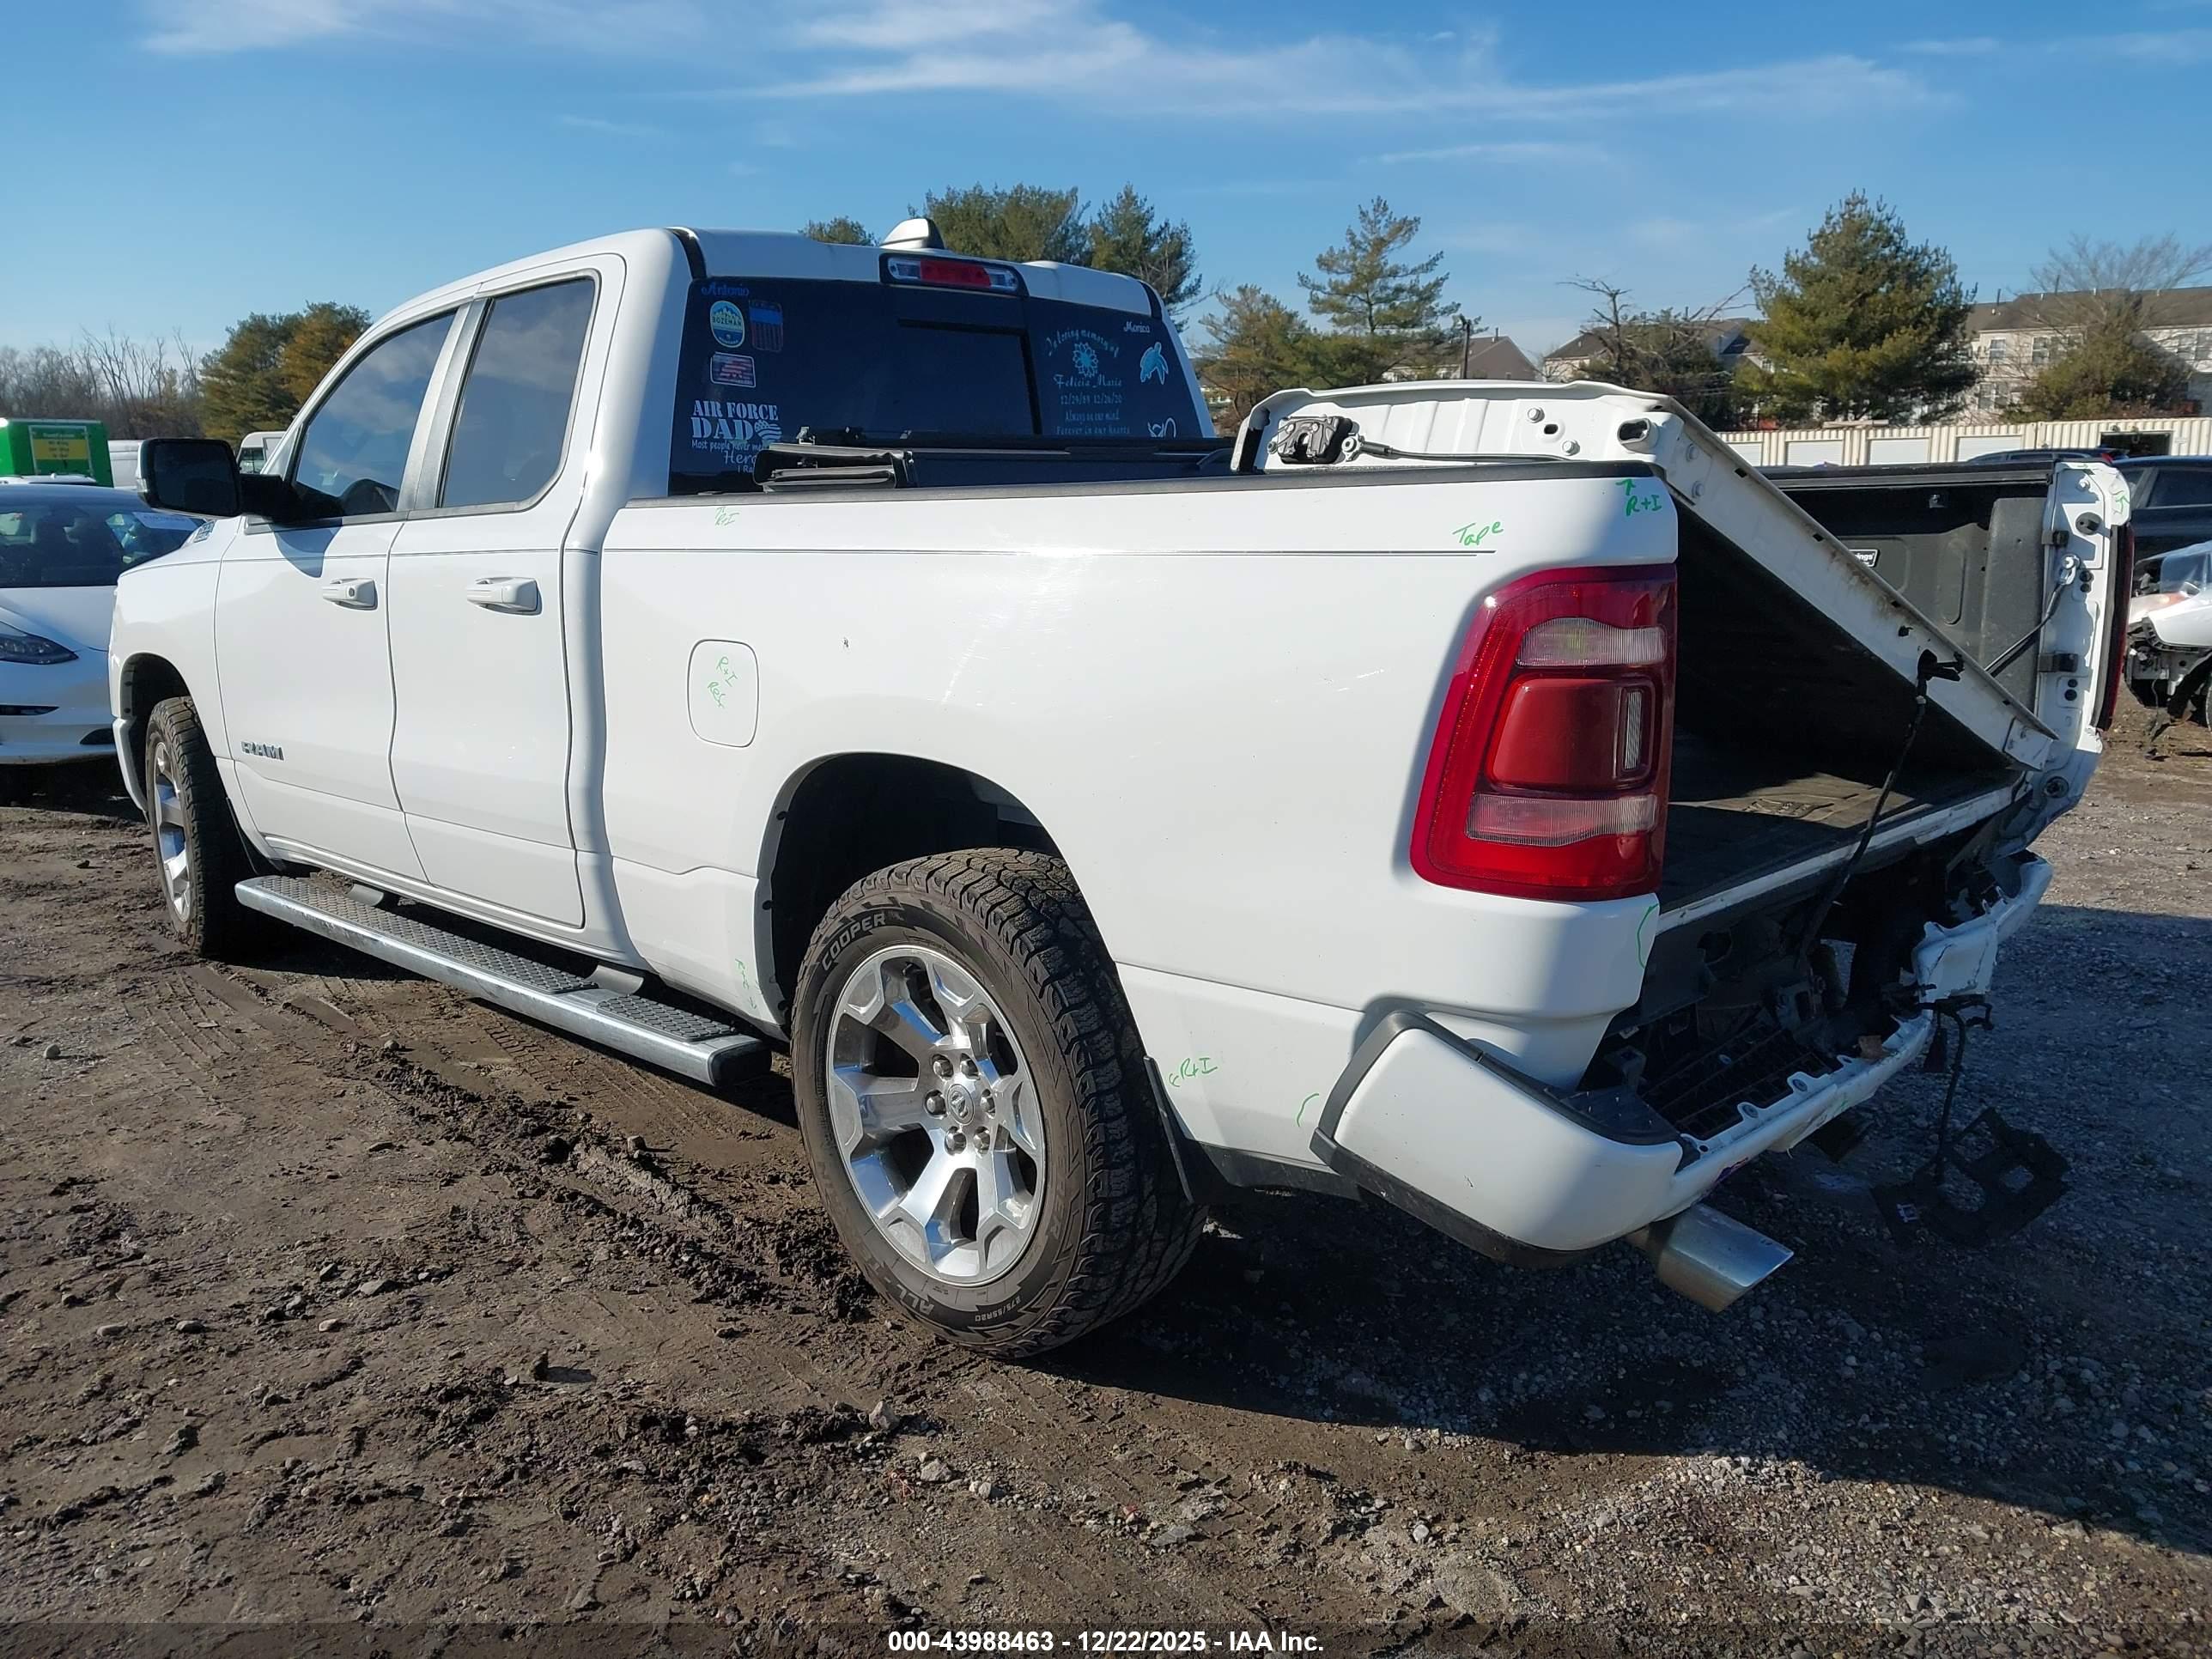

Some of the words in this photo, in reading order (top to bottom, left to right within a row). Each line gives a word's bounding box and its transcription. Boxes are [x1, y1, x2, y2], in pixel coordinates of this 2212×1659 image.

[712, 315, 742, 327] BOZEMAN
[693, 400, 723, 417] AIR
[726, 402, 779, 421] FORCE
[690, 416, 754, 441] DAD
[691, 440, 708, 449] Most
[709, 441, 730, 453] people
[1452, 520, 1504, 546] Tape
[241, 741, 284, 761] RAM
[822, 912, 886, 971] COOPER
